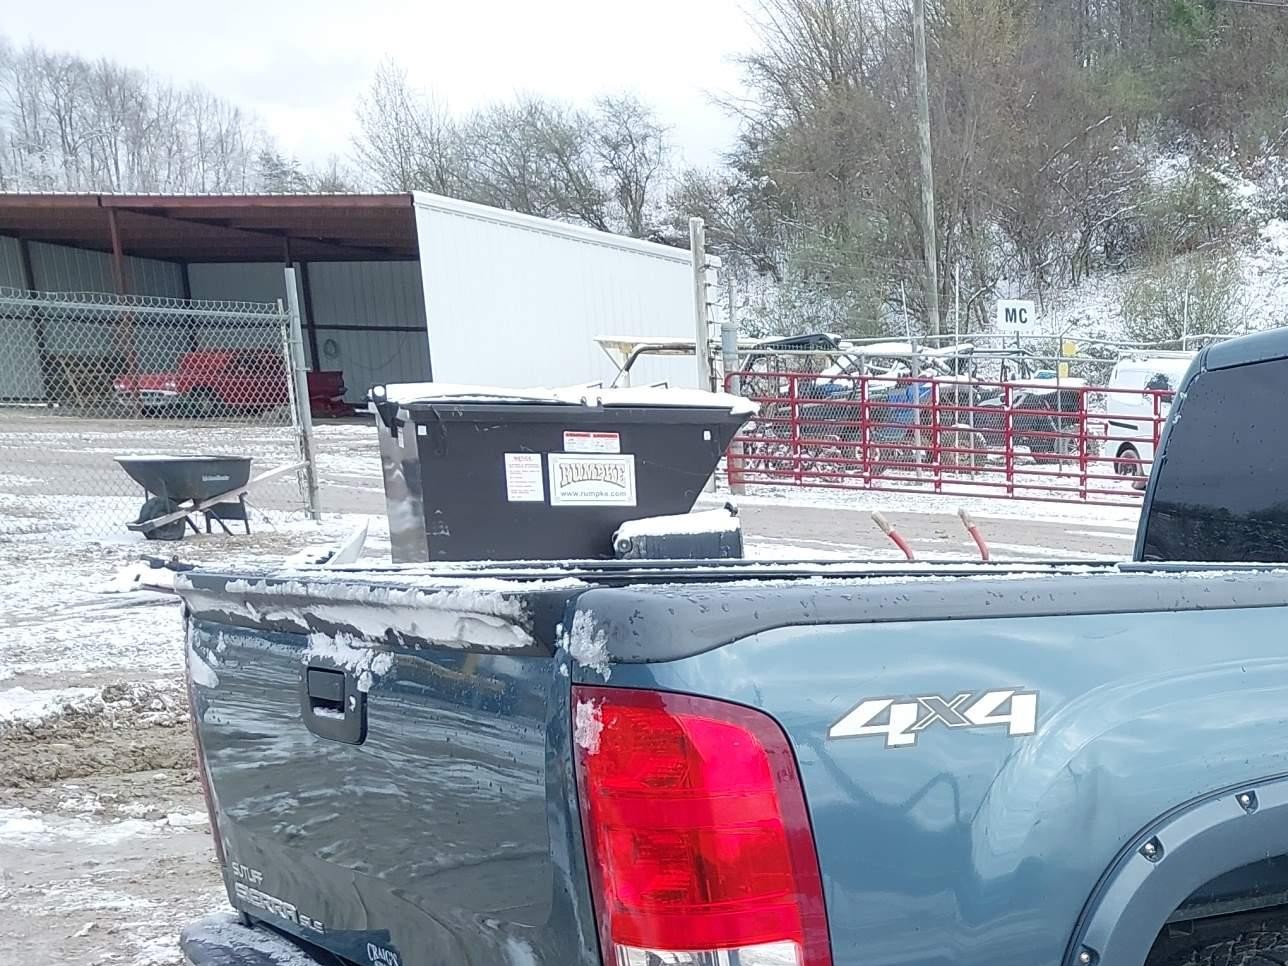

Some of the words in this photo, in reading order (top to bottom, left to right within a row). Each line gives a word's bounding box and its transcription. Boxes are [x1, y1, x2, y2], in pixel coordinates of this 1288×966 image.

[1005, 307, 1028, 324] MC
[559, 463, 626, 488] RUMPKE
[560, 489, 627, 498] www.rumpke.com
[234, 881, 299, 924] SIERRA
